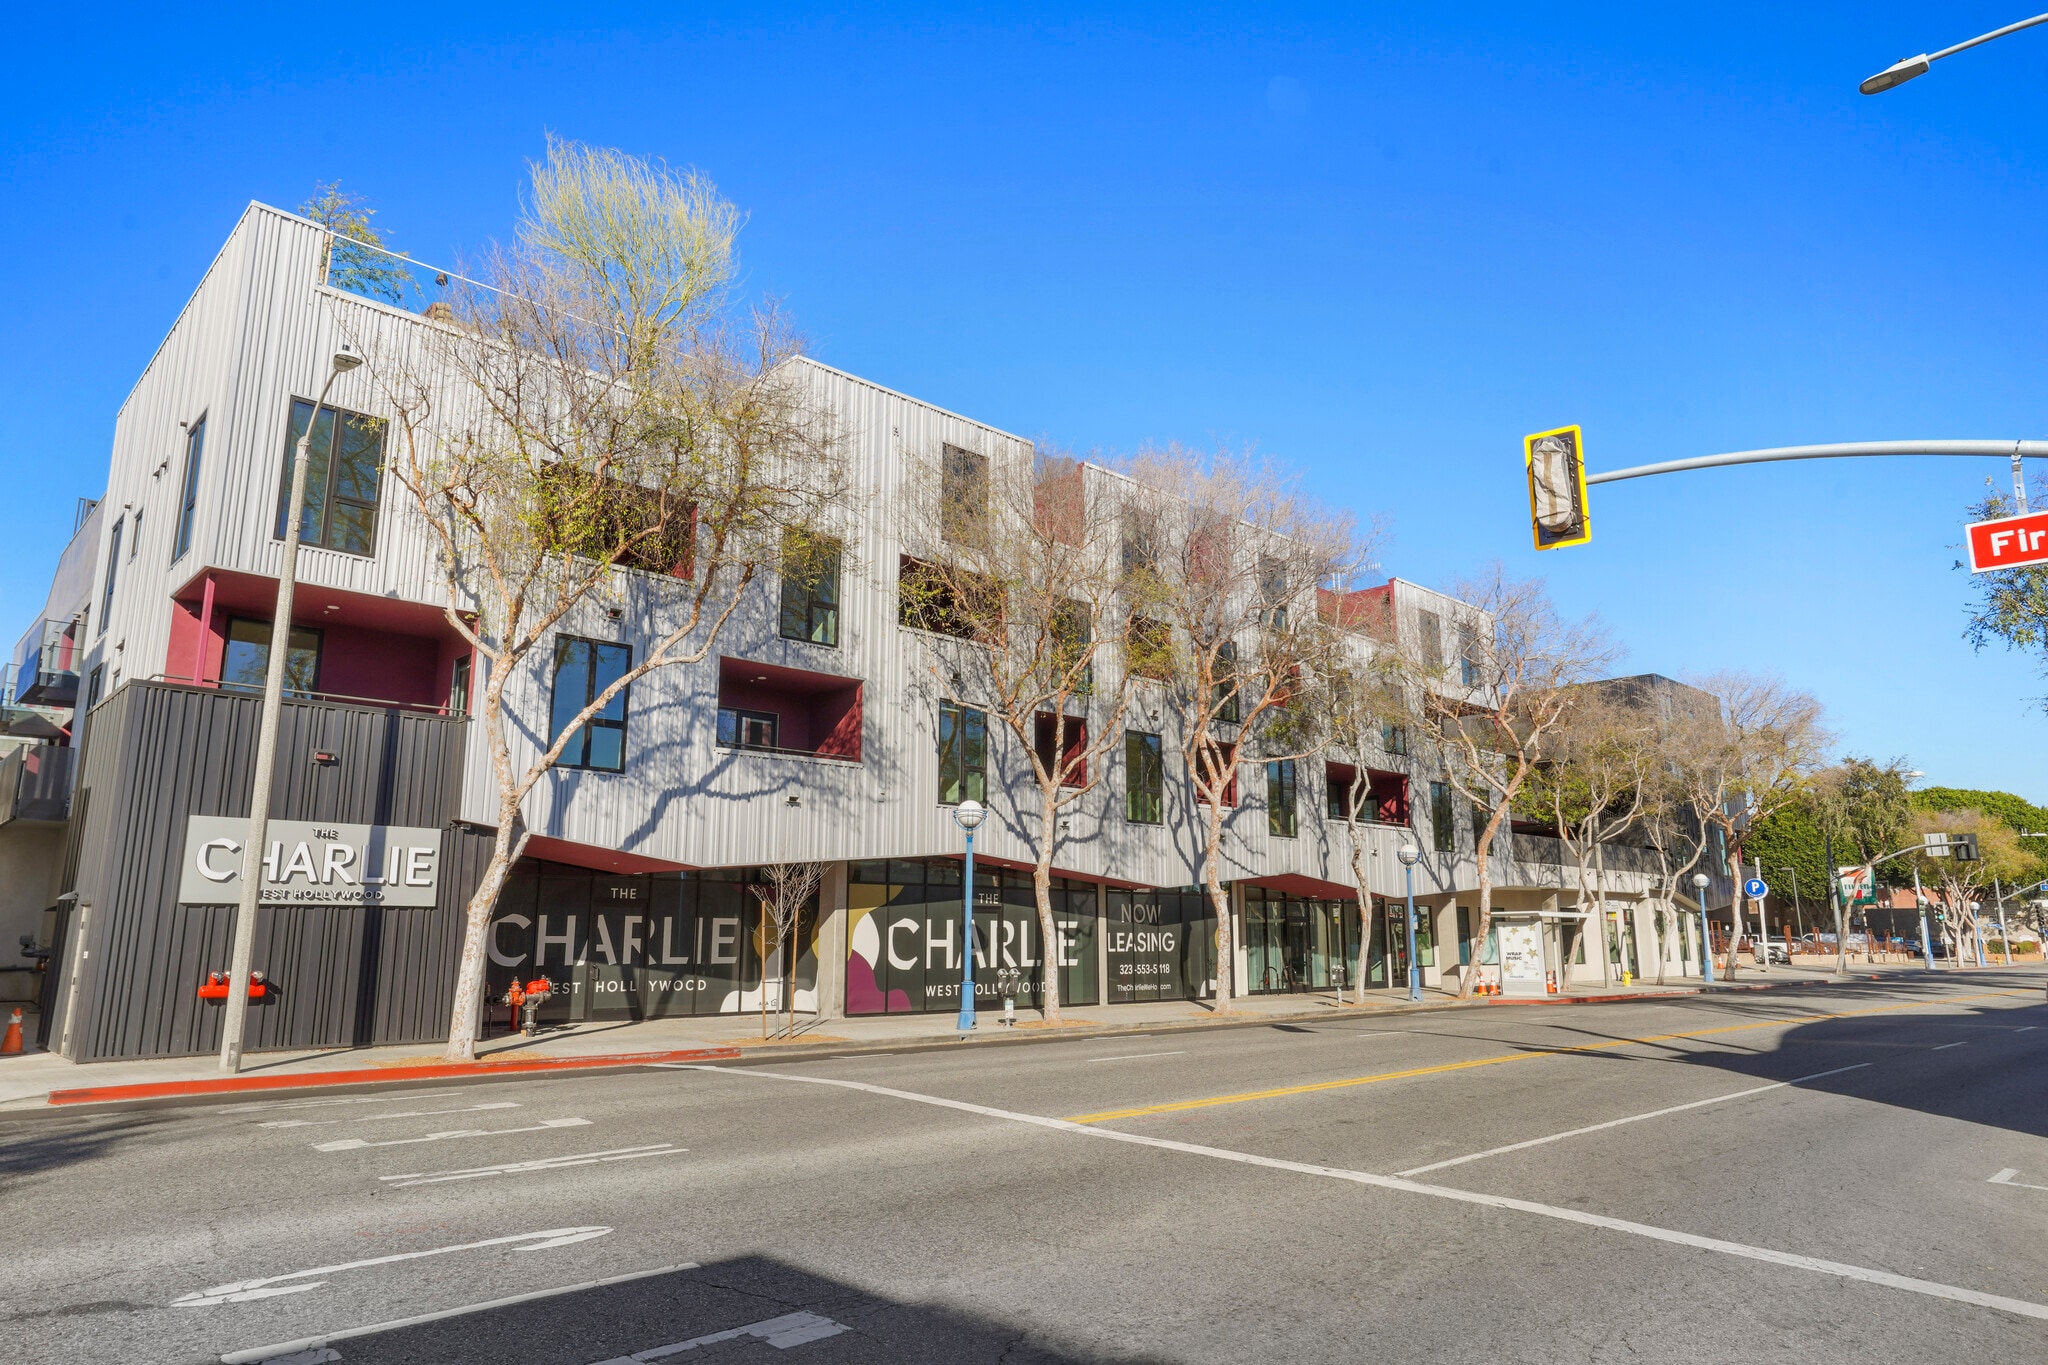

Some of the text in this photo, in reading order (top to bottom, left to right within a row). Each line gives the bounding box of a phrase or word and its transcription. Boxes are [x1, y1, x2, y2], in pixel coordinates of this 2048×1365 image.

[1990, 528, 2046, 557] Fir
[313, 828, 339, 839] THE
[196, 838, 436, 886] CHARLIE
[262, 888, 384, 901] EST HOLLYWOOD
[611, 887, 637, 899] THE
[978, 892, 999, 904] THE
[1121, 904, 1162, 924] NOW
[487, 913, 739, 967] CHARLIE
[888, 918, 1079, 970] CHARLE
[1108, 932, 1175, 953] LEASING
[551, 982, 581, 994] EST
[925, 984, 961, 997] WEST
